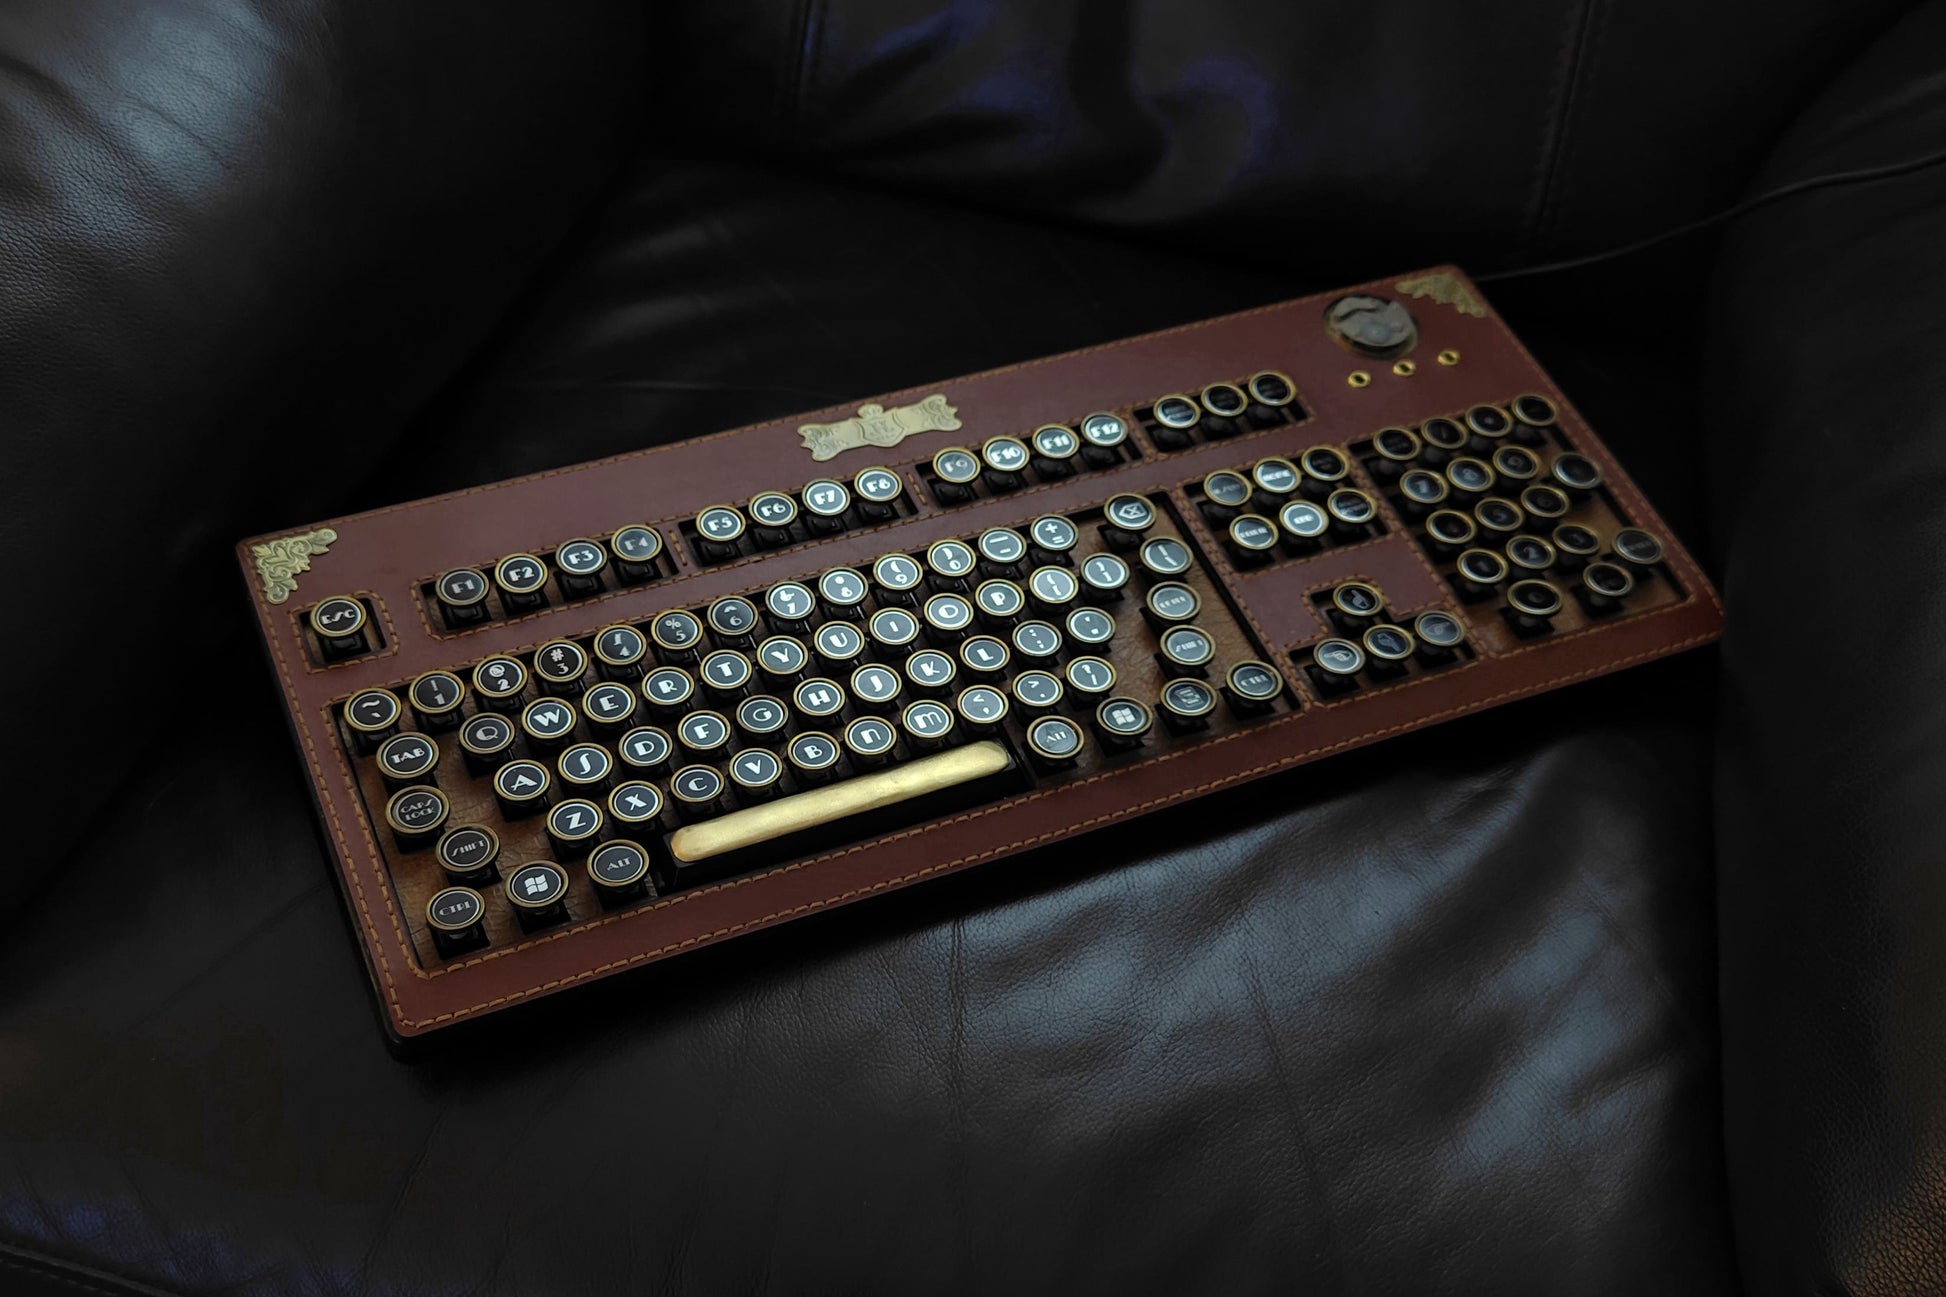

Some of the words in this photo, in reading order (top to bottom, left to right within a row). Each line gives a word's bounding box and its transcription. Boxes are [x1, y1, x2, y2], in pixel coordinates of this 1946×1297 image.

[1090, 421, 1120, 438] F12
[1042, 434, 1070, 450] F11
[990, 446, 1022, 463] F10
[944, 459, 968, 473] F9
[866, 477, 891, 493] F8
[813, 490, 836, 505] F7
[760, 502, 786, 517] F6
[707, 516, 732, 532] F5
[624, 536, 649, 551] F4
[568, 549, 594, 565] F3
[949, 560, 961, 570] 0
[508, 566, 534, 583] F2
[895, 573, 908, 584] 9
[451, 579, 475, 594] F1
[841, 587, 852, 598] 8
[990, 591, 1006, 606] P
[321, 608, 355, 625] ESC
[938, 604, 959, 619] O
[730, 615, 742, 627] 6
[676, 630, 686, 642] 5
[829, 632, 848, 648] U
[550, 648, 564, 662] #
[771, 648, 790, 663] Y
[977, 648, 994, 661] L
[489, 664, 505, 678] @
[558, 663, 569, 675] 3
[716, 661, 733, 677] T
[920, 661, 940, 676] K
[497, 679, 510, 691] 2
[657, 679, 677, 694] R
[870, 674, 883, 692] J
[434, 693, 445, 705] 1
[598, 694, 616, 712] E
[808, 689, 831, 706] H
[533, 708, 560, 727] W
[752, 707, 772, 722] G
[475, 726, 498, 741] Q
[693, 723, 709, 740] F
[391, 747, 425, 763] TAB
[633, 740, 654, 756] D
[804, 745, 823, 759] B
[580, 753, 593, 775] S
[745, 759, 761, 775] V
[510, 774, 537, 791] A
[688, 777, 708, 791] C
[400, 798, 433, 814] CAPS
[625, 793, 647, 811] X
[405, 807, 434, 821] LOCK
[566, 811, 586, 830] Z
[451, 839, 485, 857] SHIFT
[607, 857, 631, 871] ALT
[438, 900, 472, 916] CTRL
